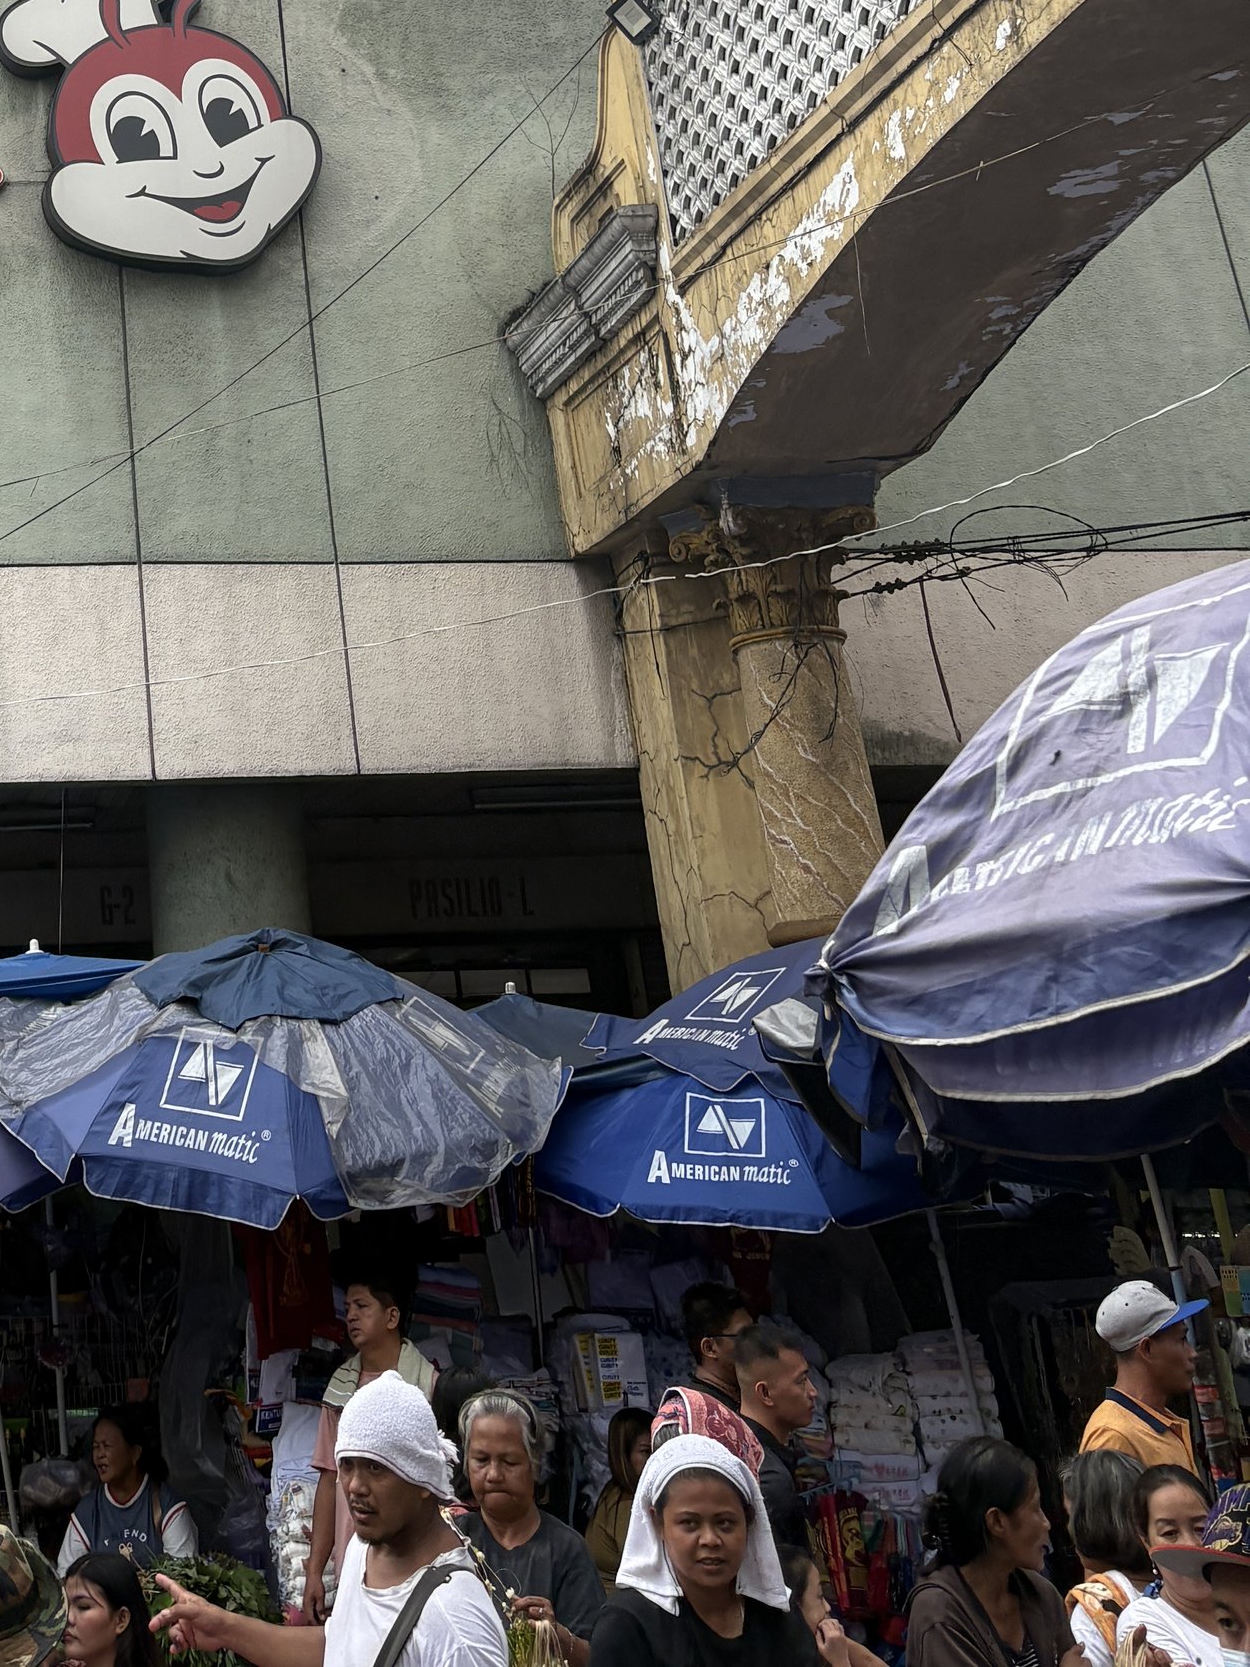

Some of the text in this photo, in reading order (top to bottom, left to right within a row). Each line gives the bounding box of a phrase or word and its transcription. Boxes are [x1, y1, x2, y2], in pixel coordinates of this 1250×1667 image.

[100, 885, 136, 926] G-2
[633, 1019, 709, 1045] AMERICAN
[107, 1102, 209, 1151] AMERICAN
[647, 1150, 740, 1184] AMERICAN
